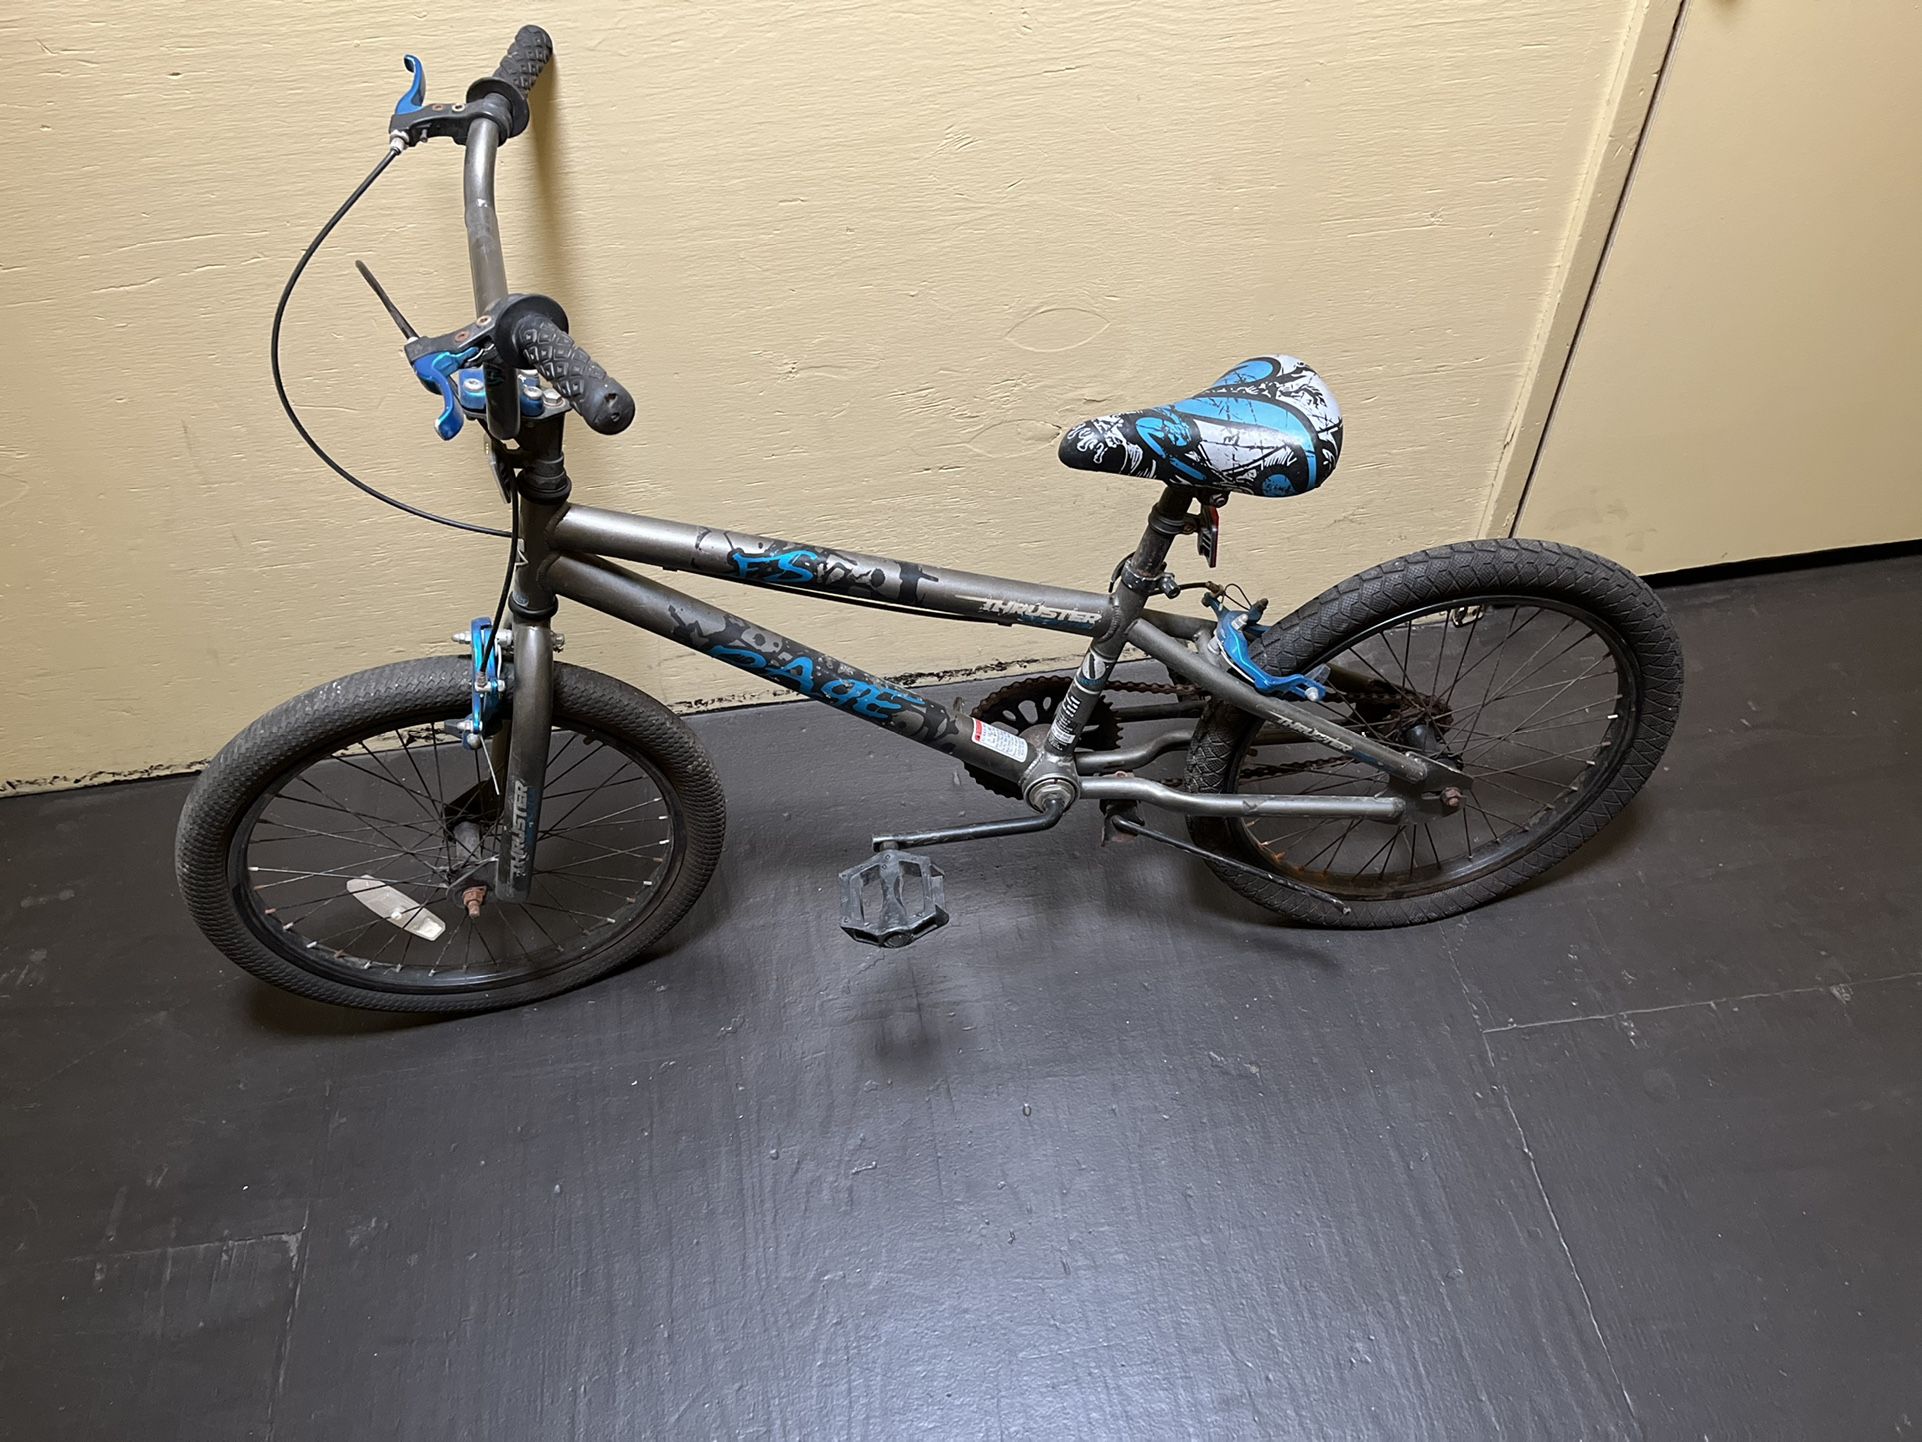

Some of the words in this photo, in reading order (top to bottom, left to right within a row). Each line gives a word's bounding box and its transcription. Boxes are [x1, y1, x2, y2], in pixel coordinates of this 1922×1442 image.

[979, 597, 1103, 625] THRUSTER
[1275, 714, 1354, 752] THRUSTER
[510, 779, 529, 878] THRUSTER
